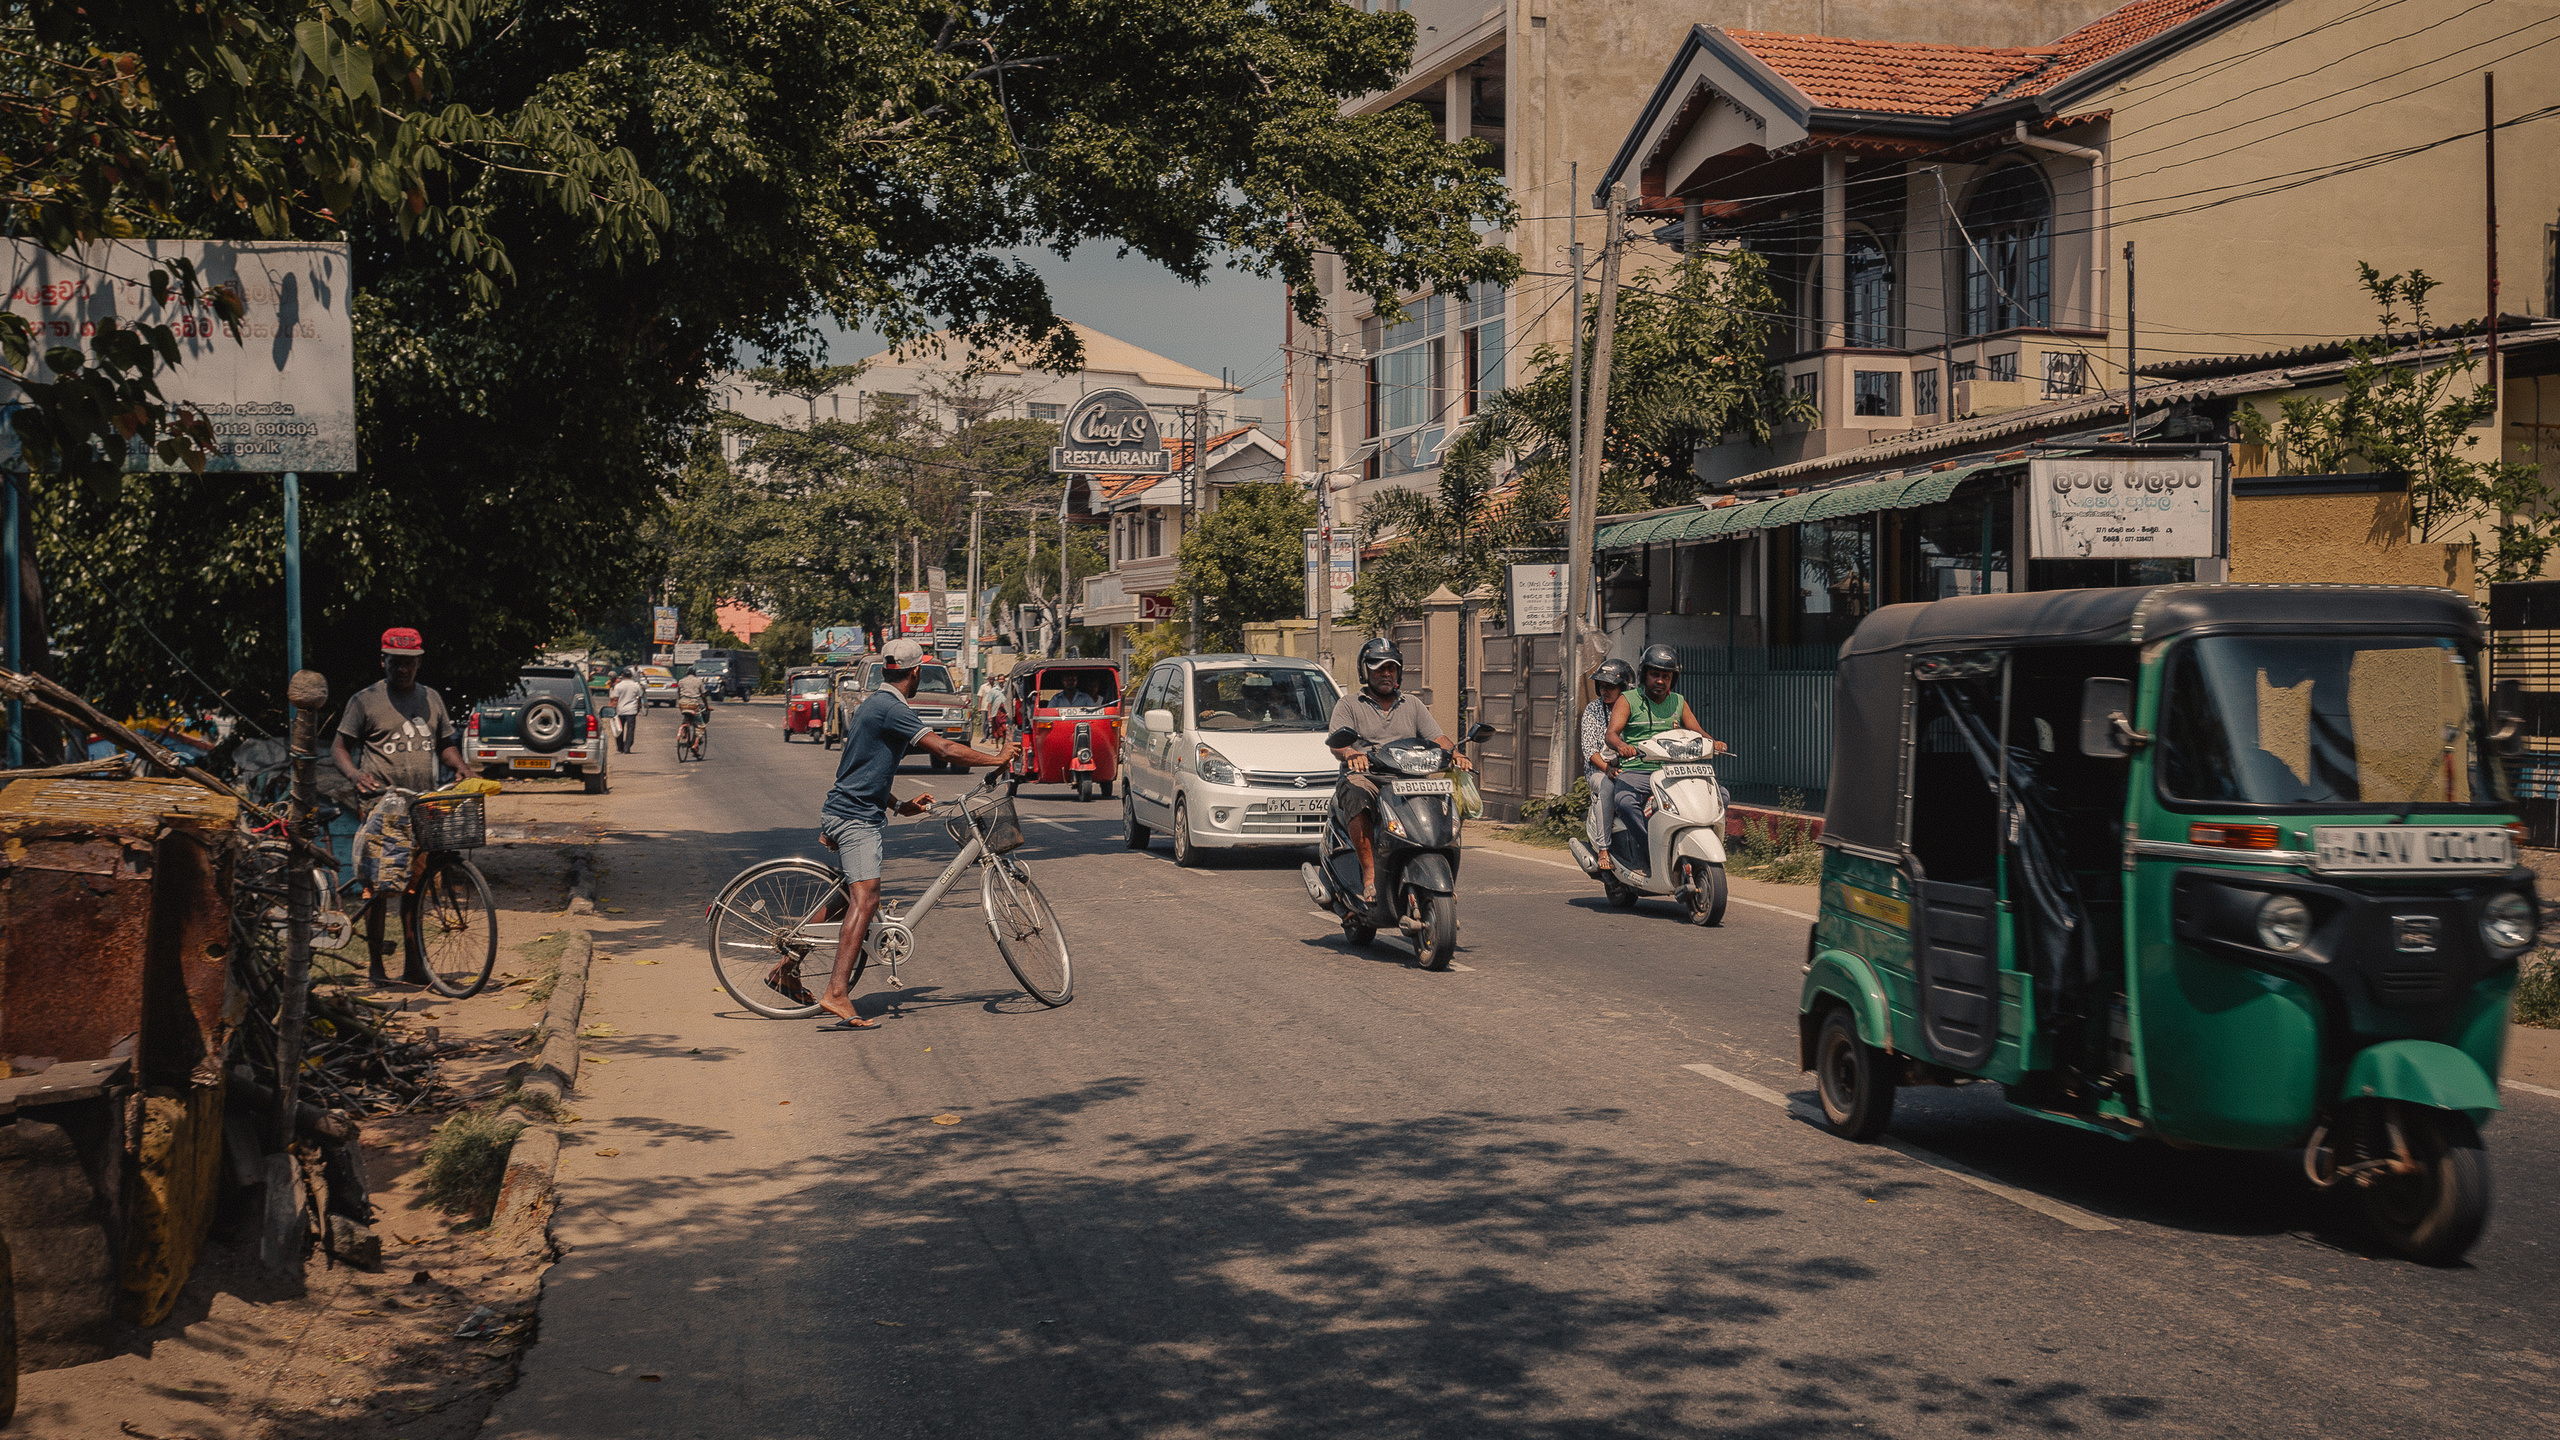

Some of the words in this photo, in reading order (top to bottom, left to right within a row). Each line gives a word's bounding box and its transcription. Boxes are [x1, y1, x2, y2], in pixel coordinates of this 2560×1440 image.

[254, 423, 318, 436] 690604
[1062, 450, 1163, 466] RESTAURANT
[1141, 597, 1177, 618] Pizz
[1280, 799, 1296, 811] KL
